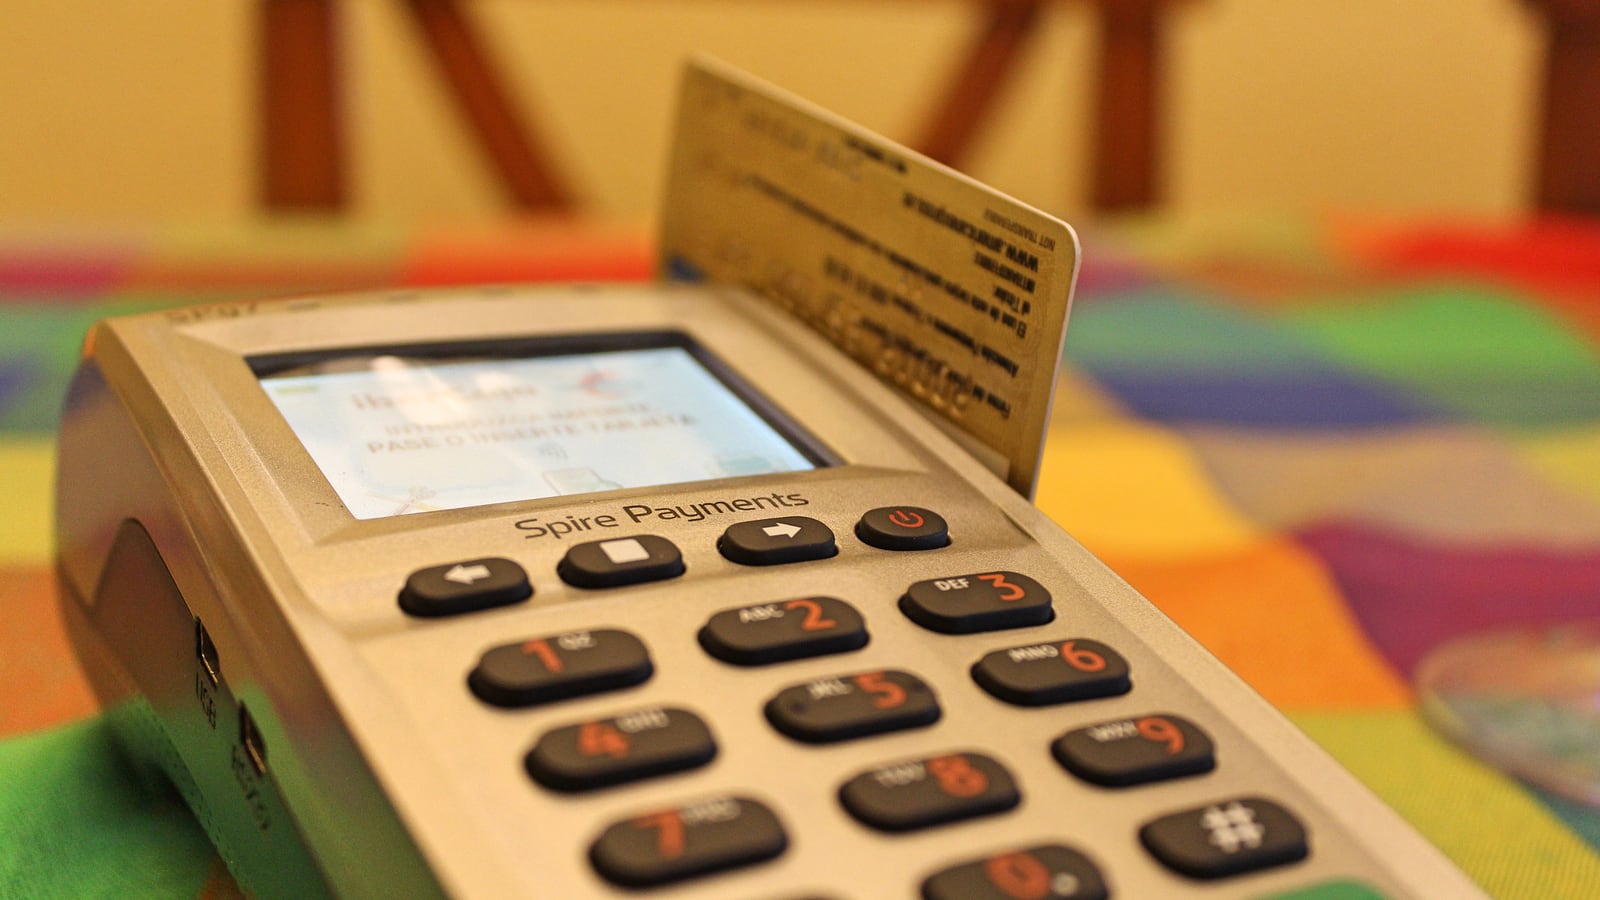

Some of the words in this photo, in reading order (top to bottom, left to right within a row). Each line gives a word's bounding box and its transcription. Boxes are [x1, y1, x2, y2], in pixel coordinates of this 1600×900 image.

[1040, 233, 1055, 251] NOT
[366, 435, 440, 454] PASE
[472, 423, 577, 443] INSERTE
[514, 514, 619, 540] Spire
[622, 493, 810, 523] Payments
[933, 578, 970, 592] DEF
[977, 573, 1025, 601] 3
[738, 604, 784, 623] ABC
[785, 599, 837, 631] 2
[522, 638, 564, 673] 1
[1061, 641, 1107, 672] 6
[854, 671, 907, 709] 5
[578, 720, 630, 757] 4
[1135, 717, 1186, 754] 9
[924, 752, 989, 798] 8
[632, 809, 685, 859] 7
[984, 851, 1051, 900] 0
